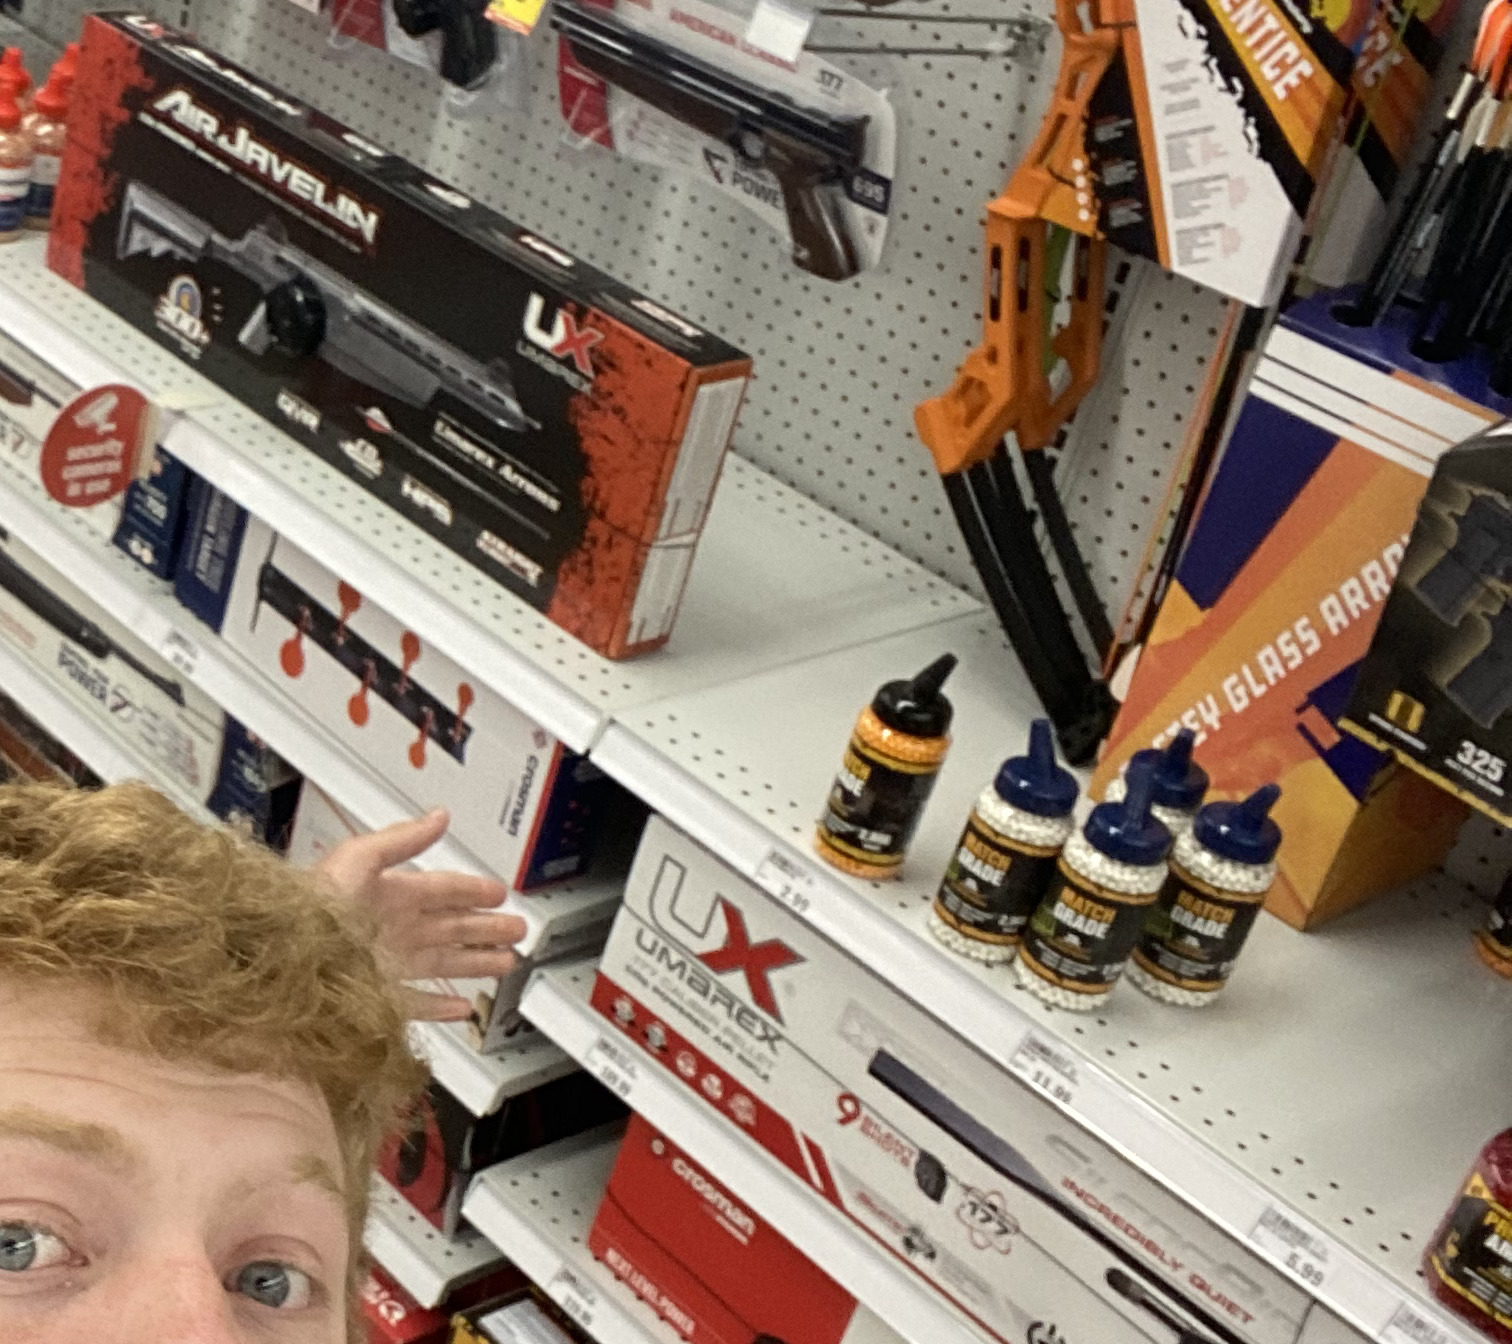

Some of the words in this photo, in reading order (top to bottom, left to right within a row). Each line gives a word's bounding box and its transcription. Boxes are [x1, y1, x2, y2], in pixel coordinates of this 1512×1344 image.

[731, 172, 784, 210] POWE
[522, 290, 606, 380] UX
[1225, 616, 1324, 719] GLASS
[1326, 533, 1410, 637] ARRO
[1456, 740, 1507, 784] 325
[958, 847, 1006, 887] GRADE
[966, 830, 1012, 872] MATCH
[1053, 901, 1112, 940] GRADE
[1059, 887, 1117, 923] MATCH
[1169, 904, 1231, 940] GRADE
[1176, 890, 1236, 923] MATCH
[648, 853, 808, 1027] UX
[836, 1090, 861, 1126] 9
[671, 1157, 757, 1235] crosman
[1061, 1174, 1186, 1274] INCREDIBLY
[1187, 1270, 1258, 1326] QUIET
[1284, 1253, 1326, 1288] 5.99
